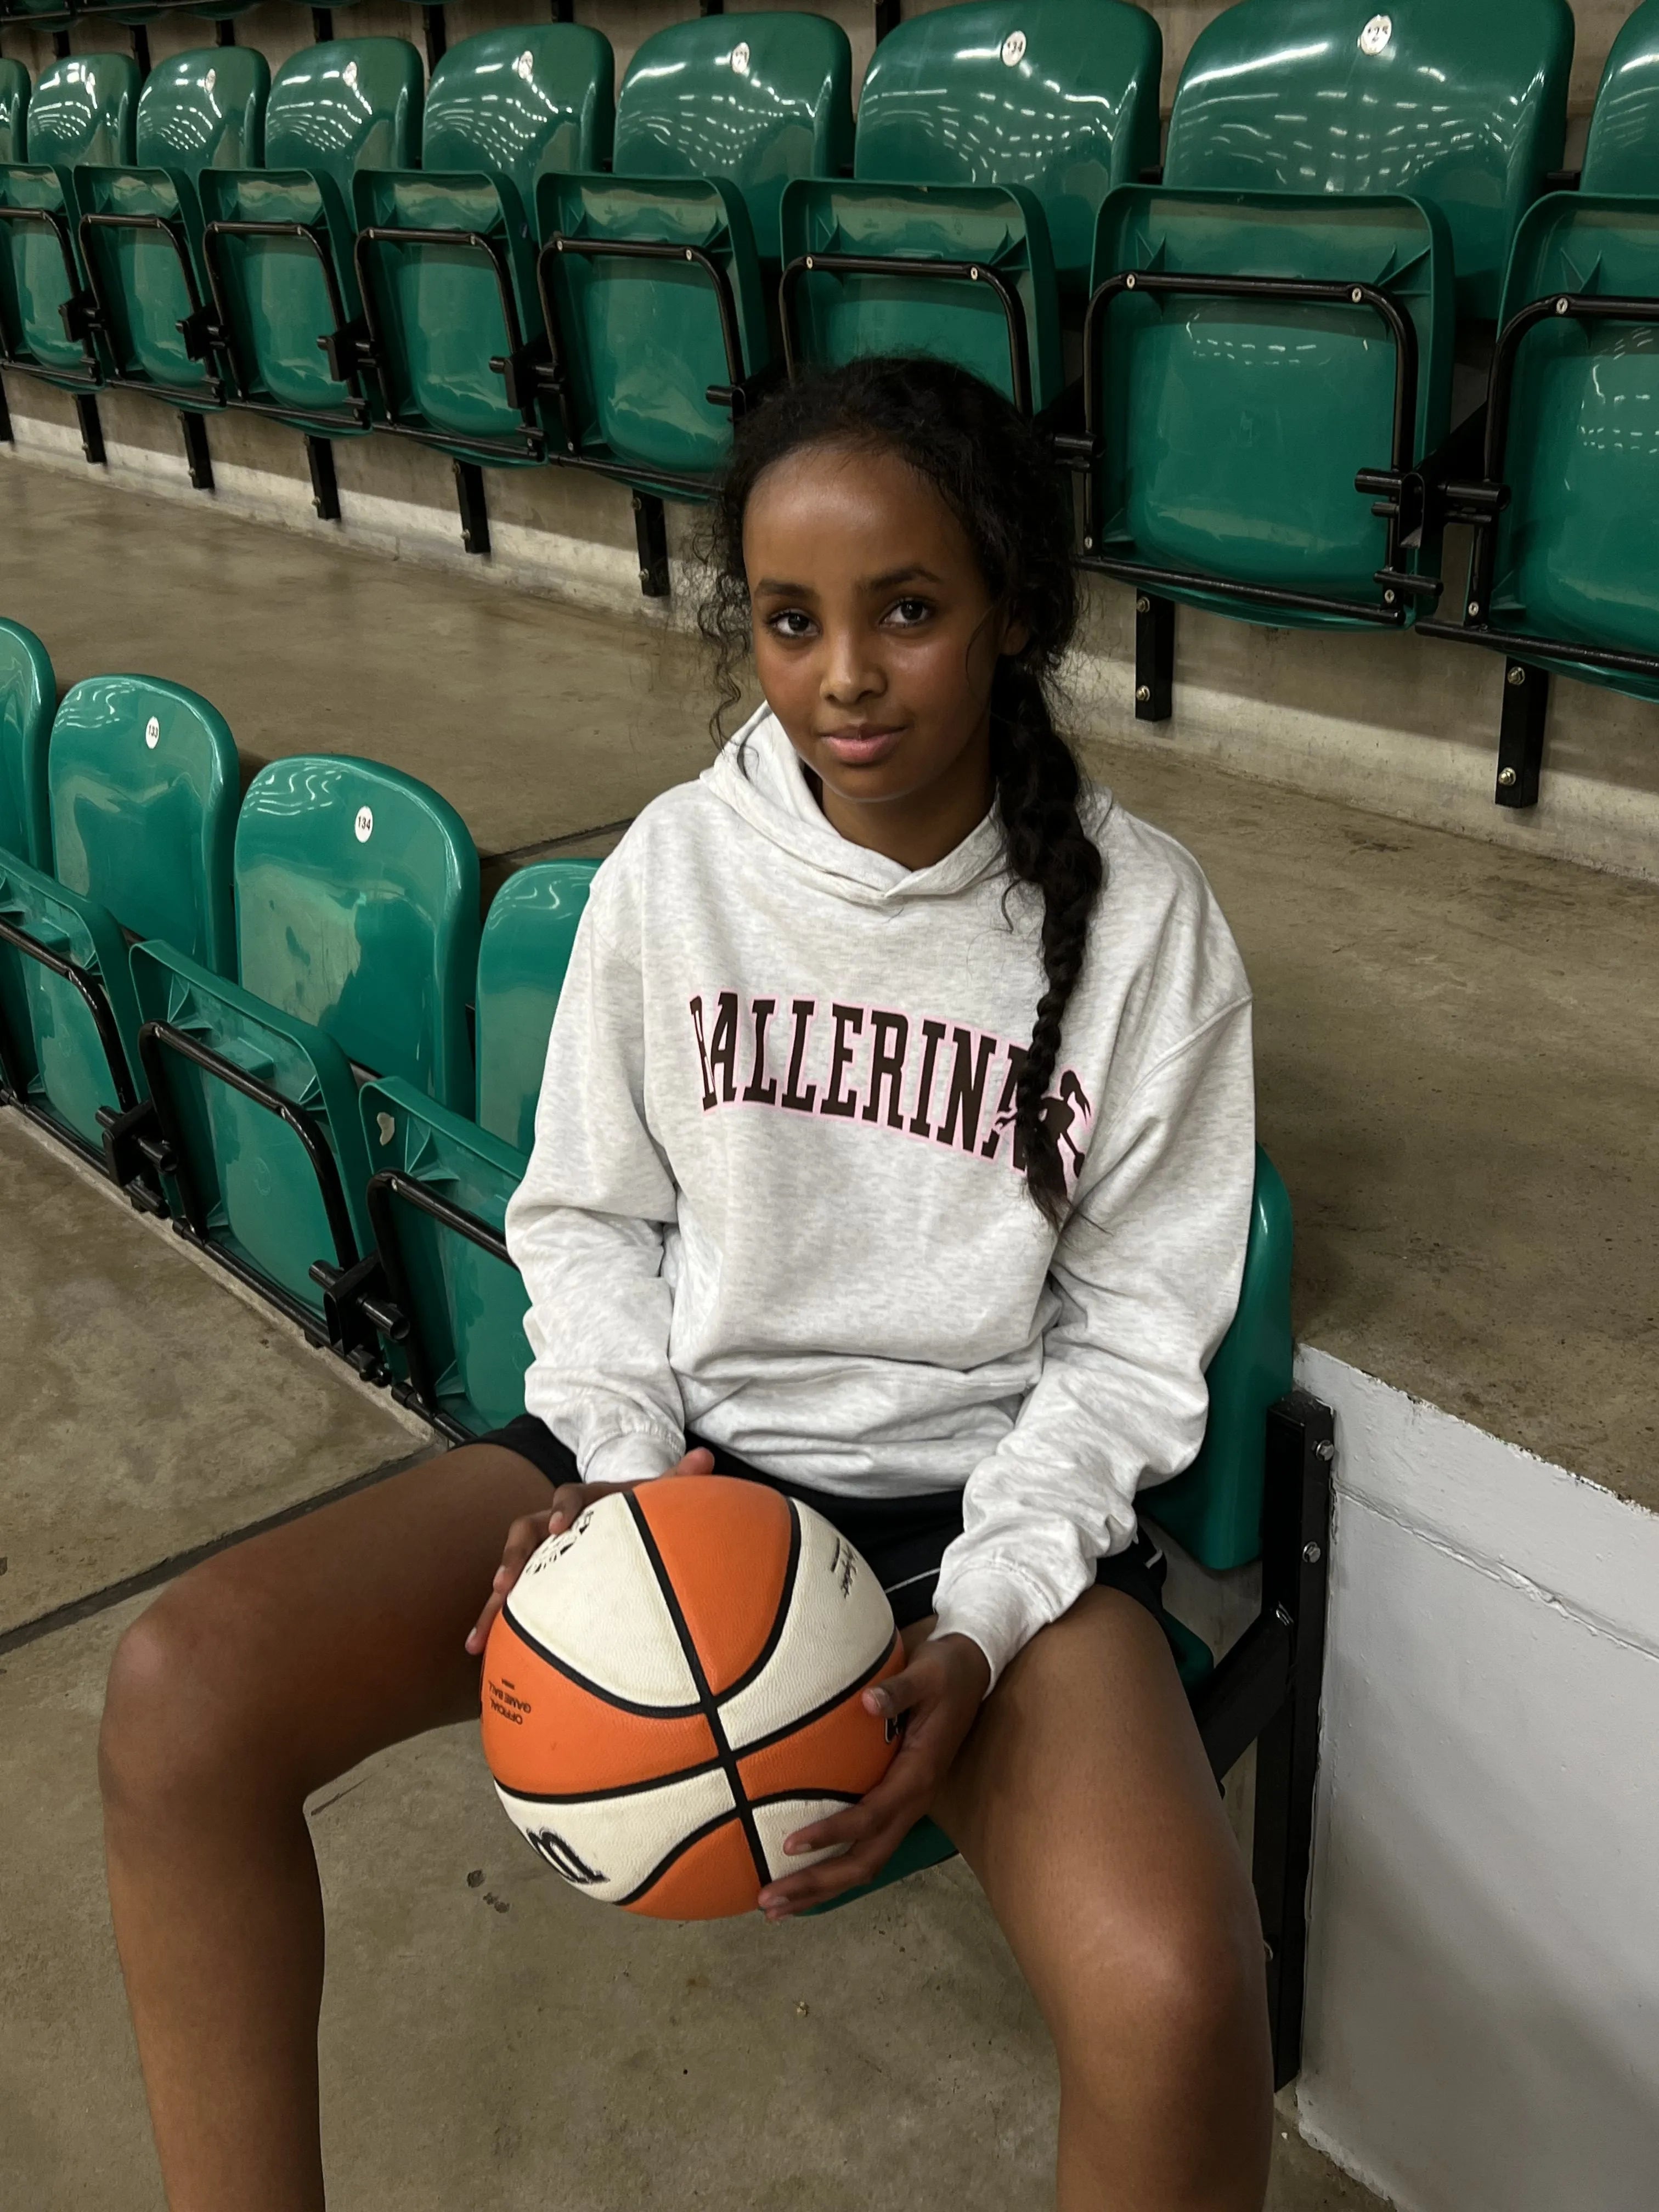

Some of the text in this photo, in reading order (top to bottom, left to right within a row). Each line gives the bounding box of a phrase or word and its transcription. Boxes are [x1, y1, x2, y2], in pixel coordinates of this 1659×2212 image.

[149, 724, 158, 738] 133
[358, 816, 371, 831] 134
[488, 1680, 503, 1700] BALL
[490, 1696, 523, 1725] OFFICIAL
[503, 1692, 531, 1714] GAME
